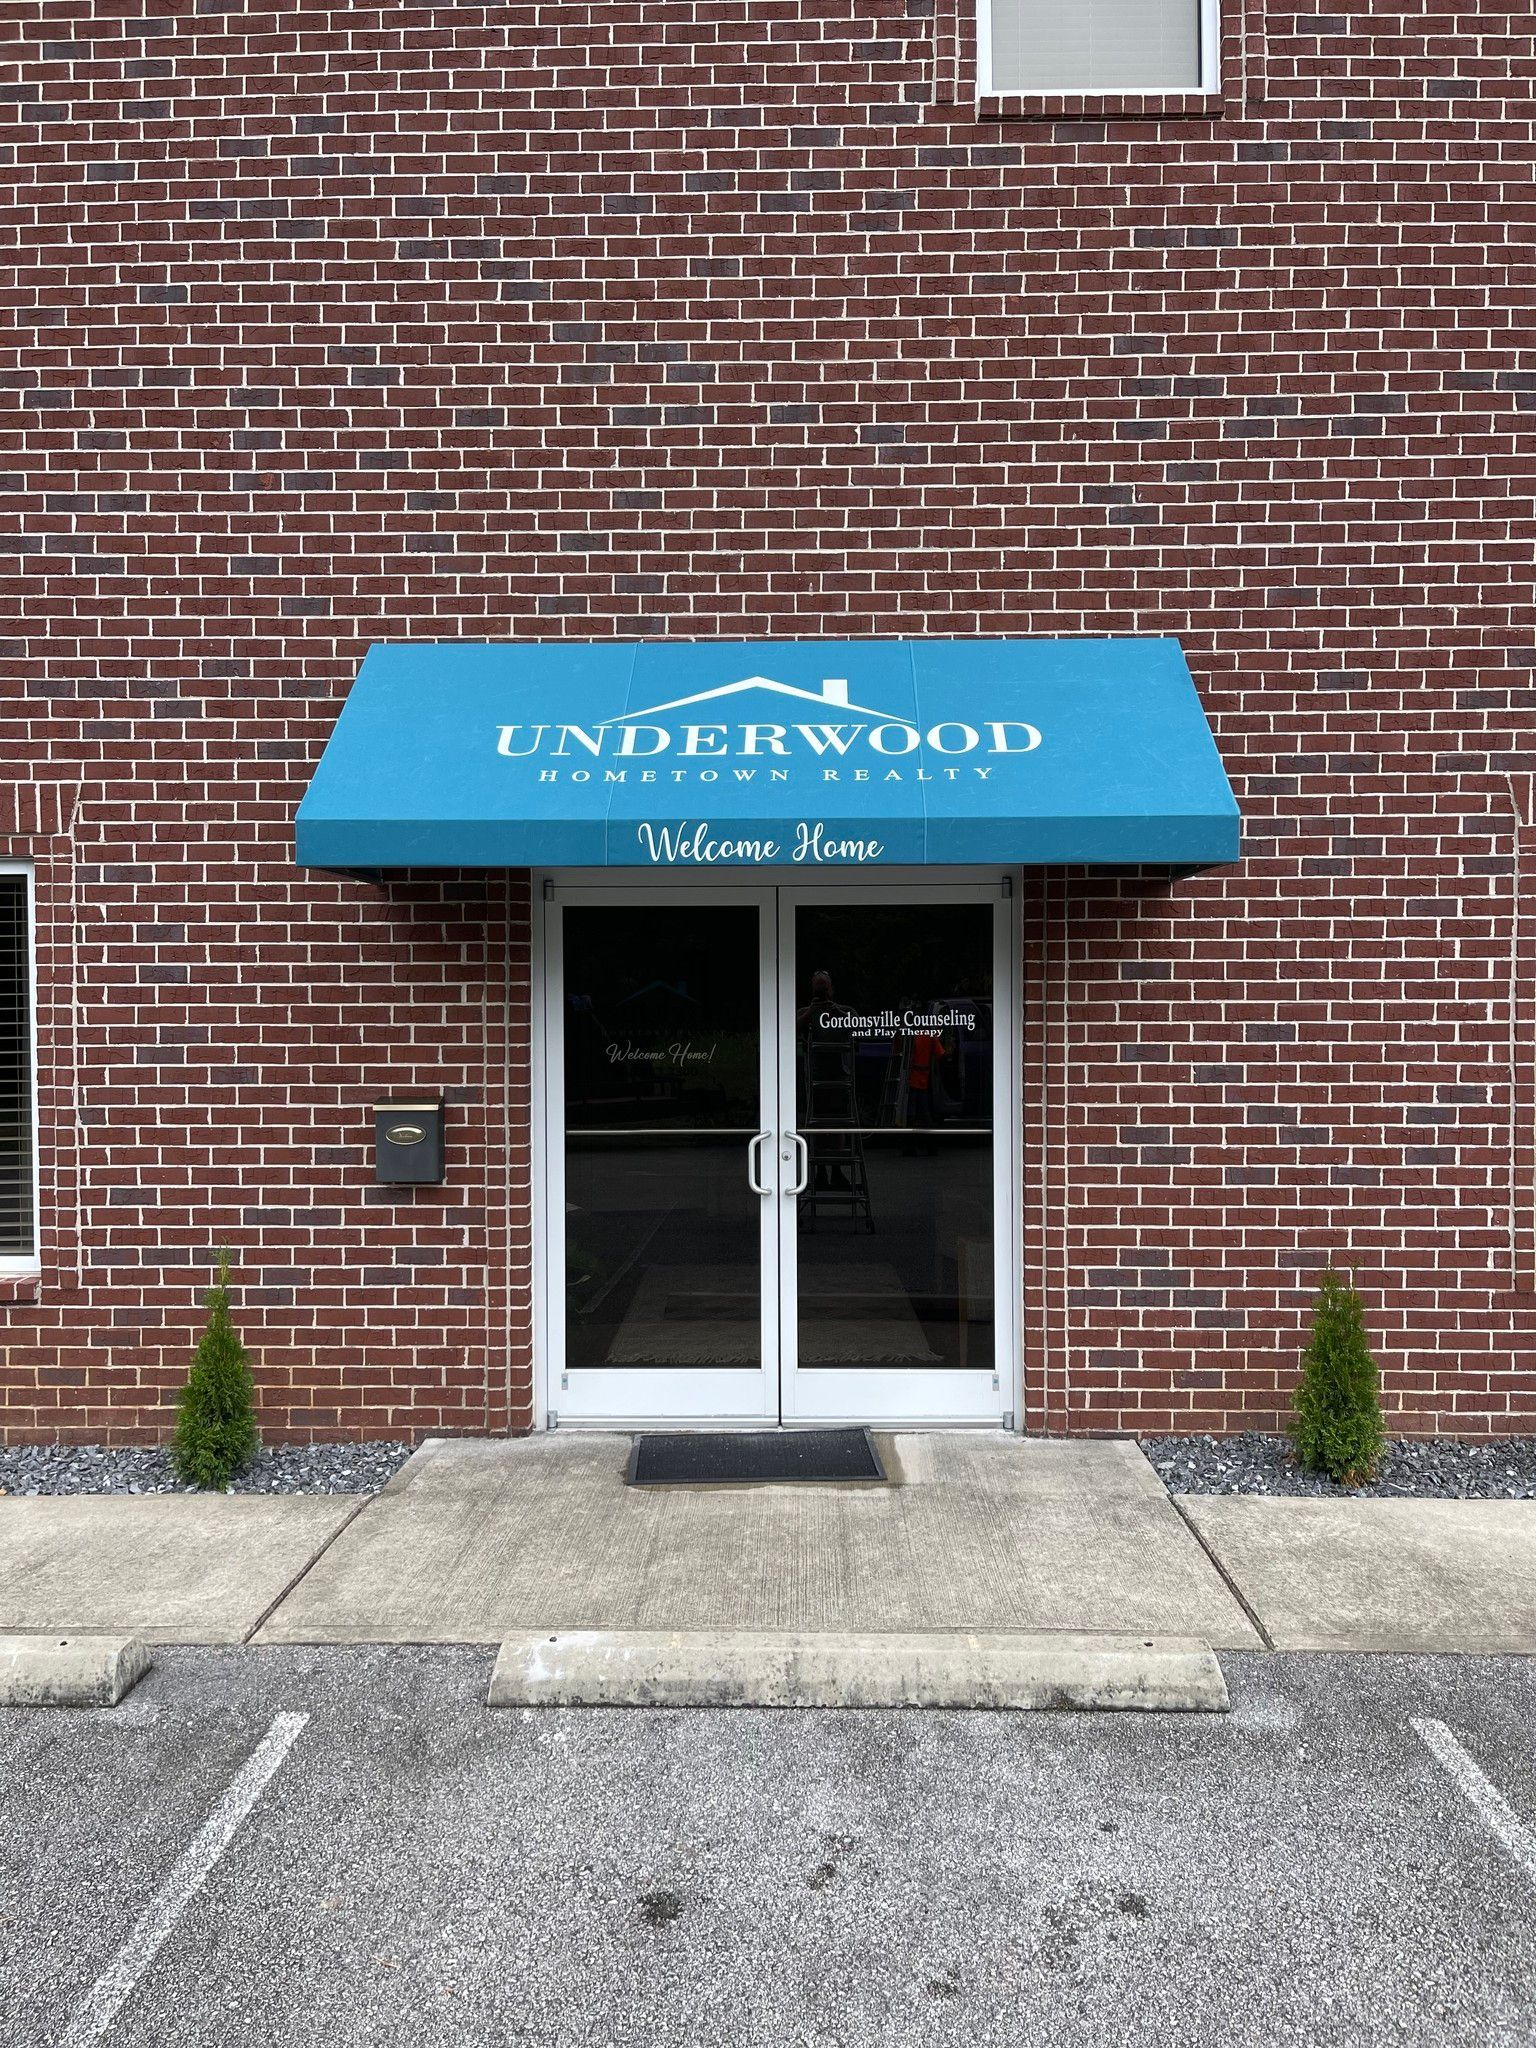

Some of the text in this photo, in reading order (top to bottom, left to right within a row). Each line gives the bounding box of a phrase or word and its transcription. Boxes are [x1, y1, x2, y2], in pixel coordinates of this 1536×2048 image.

[496, 722, 1043, 757] UNDERWOOD
[538, 766, 994, 783] HOMETOWN REALTY
[638, 821, 886, 863] Welcome Home
[819, 1009, 976, 1031] Gordonsville Counseling
[851, 1027, 944, 1038] and Play Therapy
[605, 1040, 717, 1067] Welcome Home!
